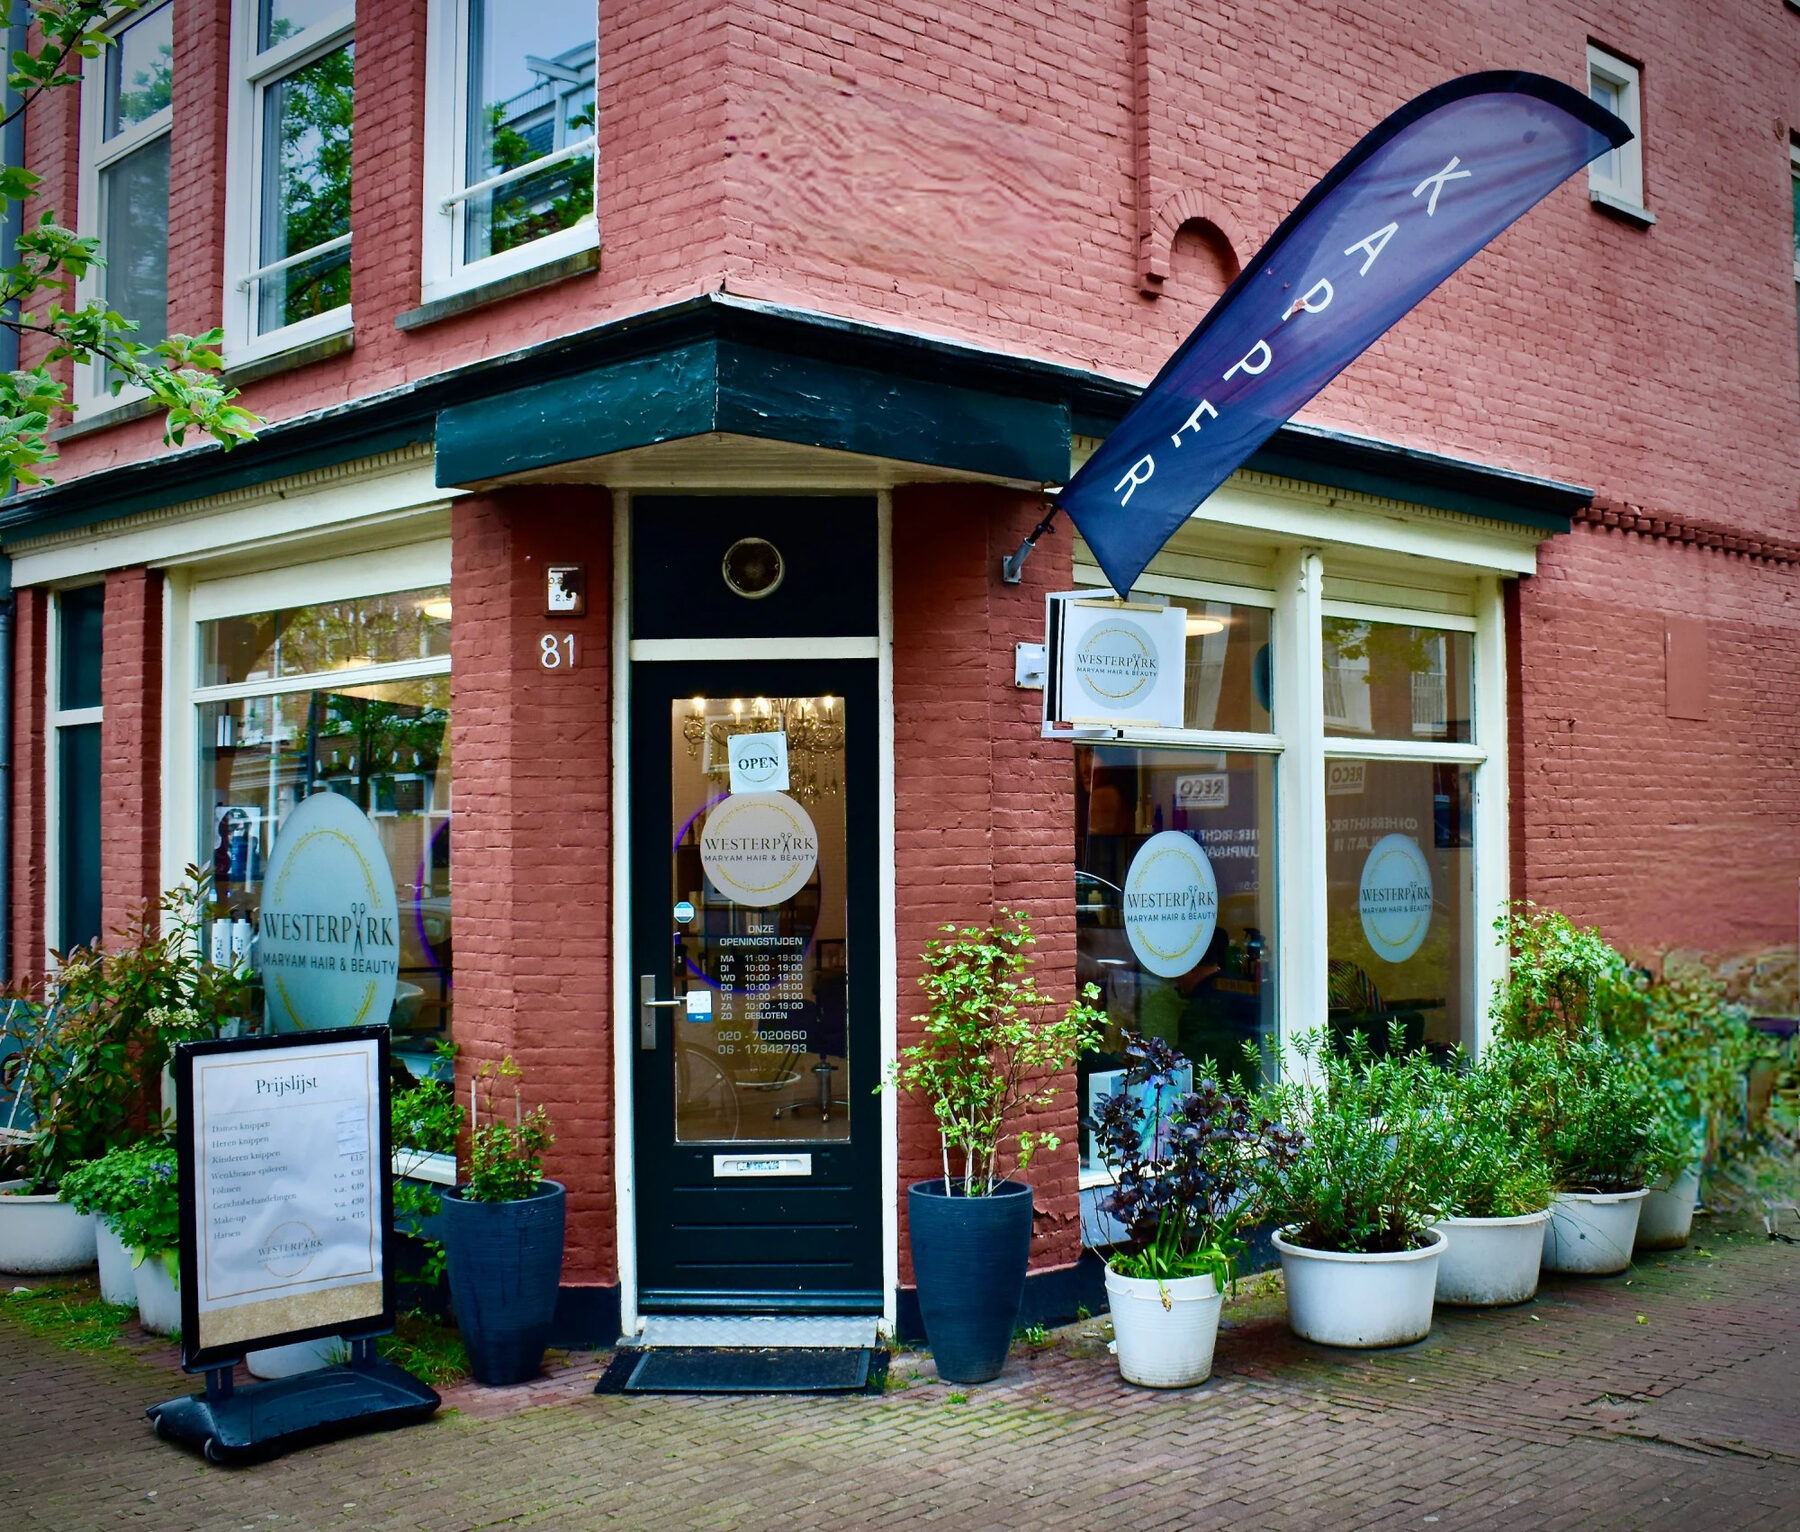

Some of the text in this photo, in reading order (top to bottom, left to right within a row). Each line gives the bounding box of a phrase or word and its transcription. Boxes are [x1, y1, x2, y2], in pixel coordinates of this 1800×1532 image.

[1113, 155, 1472, 507] KAPPER
[541, 634, 575, 669] 81
[1078, 654, 1156, 670] WESTERPARK
[738, 756, 779, 771] OPEN
[705, 833, 814, 854] WESTERPARK
[1128, 886, 1215, 910] WESTERPARK
[1362, 884, 1431, 902] WESTERPARK
[1127, 914, 1158, 923] MARYAM
[1162, 913, 1178, 921] HAIR
[1189, 912, 1216, 920] BEAUTY
[263, 906, 394, 951] WESTERPARK
[748, 925, 774, 934] ONZE
[720, 937, 803, 946] OPENINGSTIJDEN
[263, 953, 396, 975] MARYAM HAIR & BEAUTY
[745, 964, 770, 972] 10:00
[720, 974, 736, 982] WO
[720, 993, 733, 1001] VR
[745, 1012, 788, 1020] GESLOTEN
[718, 1031, 741, 1041] 020
[752, 1031, 807, 1041] 7020660
[718, 1045, 735, 1054] 06
[746, 1044, 807, 1054] 17942793
[256, 1074, 318, 1097] Prijslijst
[240, 1121, 271, 1131] knippen
[212, 1136, 269, 1148] Heren knippen
[212, 1150, 281, 1164] Kinderen knippen
